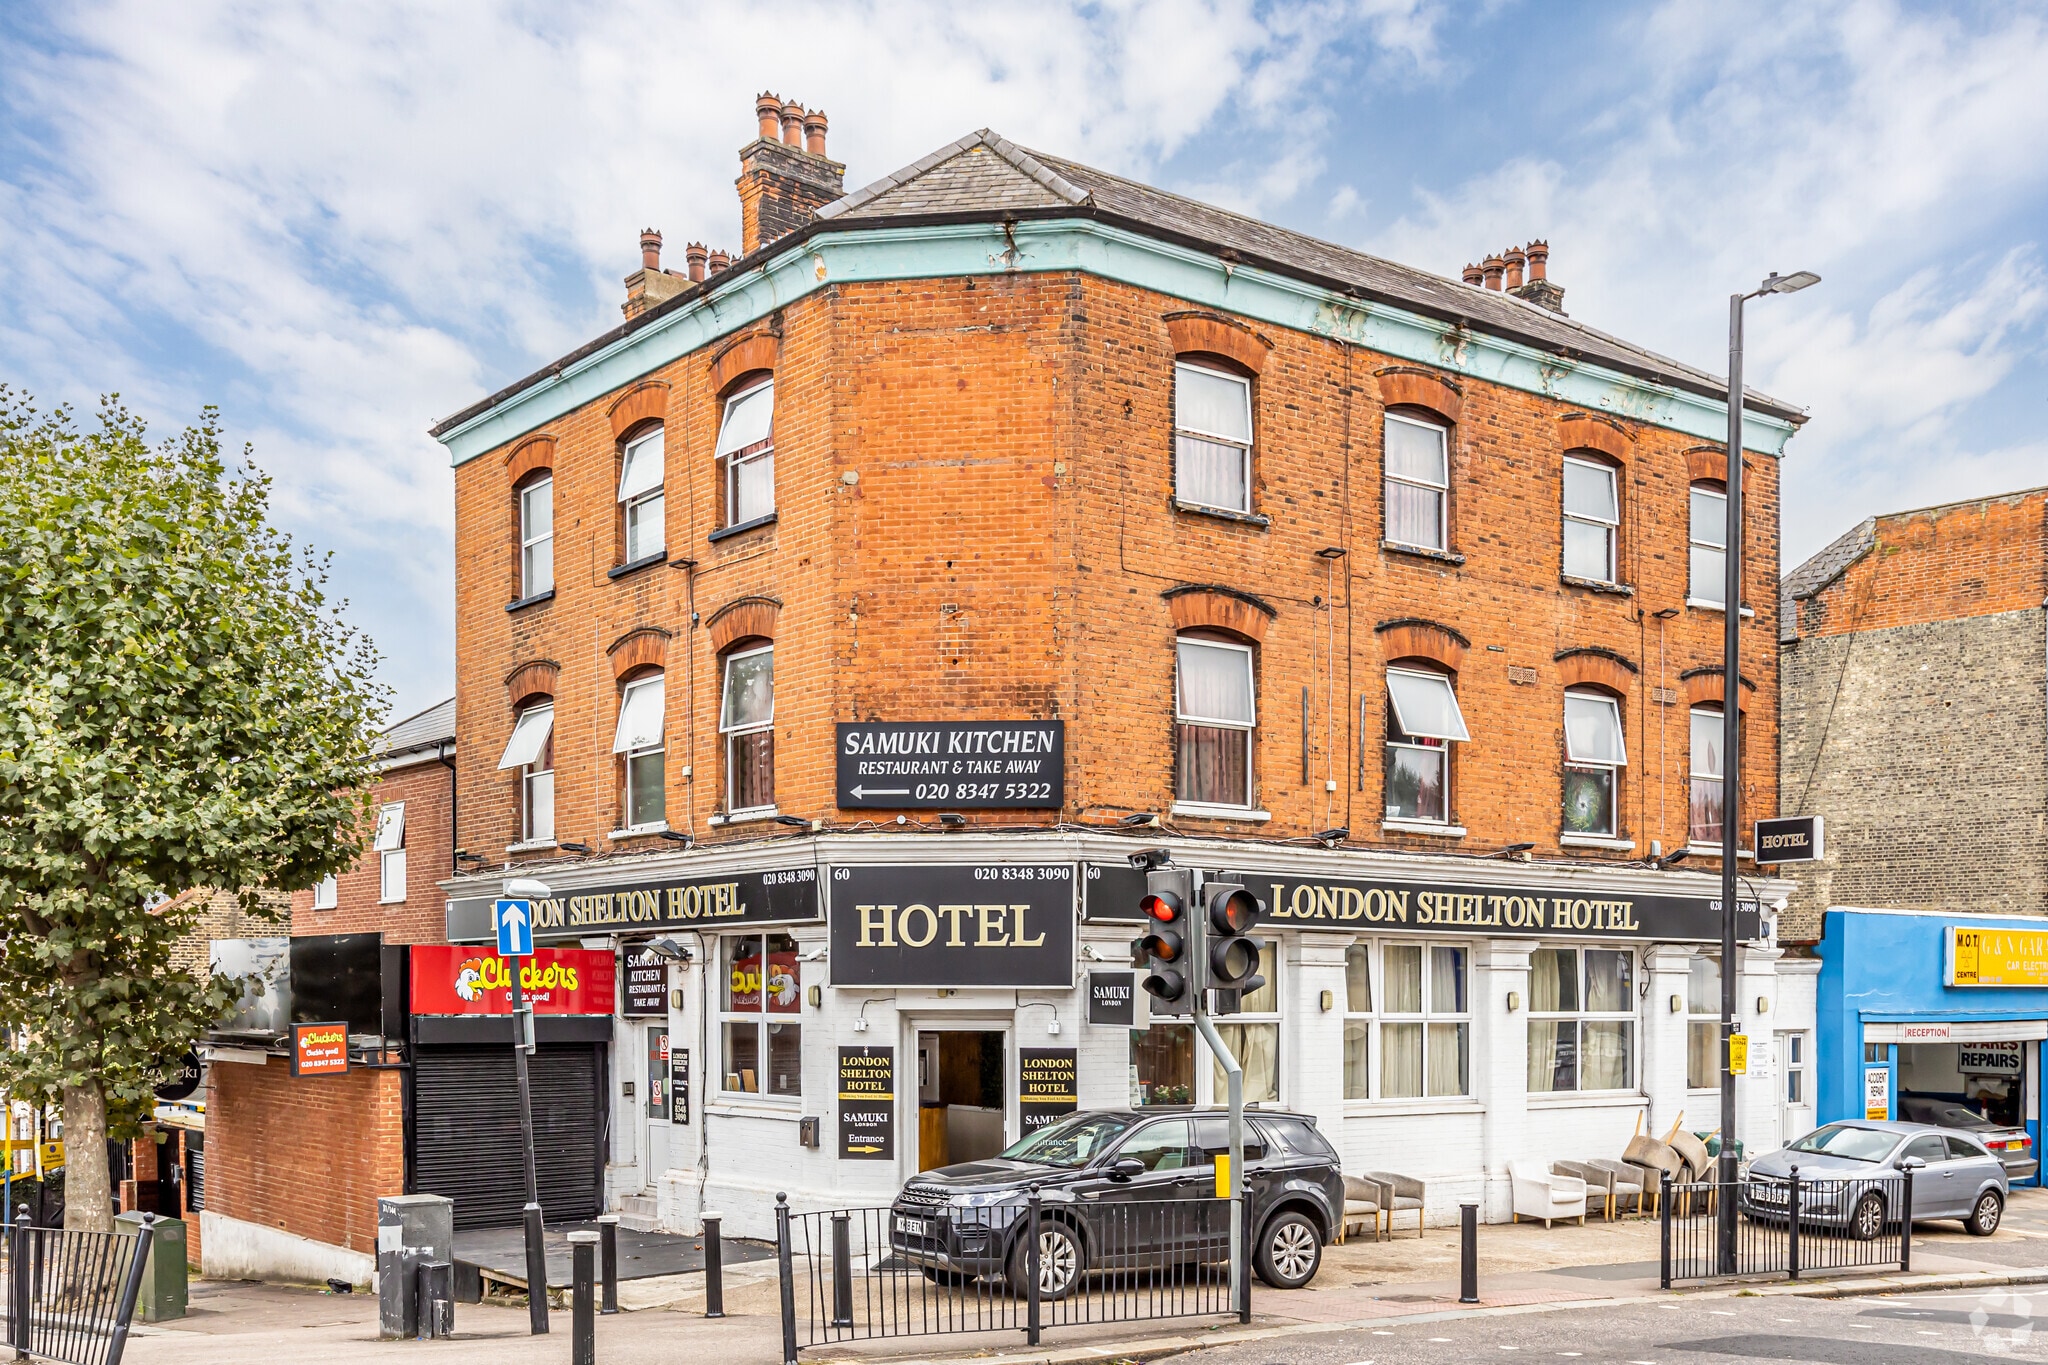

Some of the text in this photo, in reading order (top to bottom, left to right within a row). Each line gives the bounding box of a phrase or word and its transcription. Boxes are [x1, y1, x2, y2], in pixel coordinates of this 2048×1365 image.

[844, 730, 1055, 755] SAMUKI KITCHEN
[858, 759, 1041, 775] RESTAURANT & TAKE AWAY
[915, 783, 1051, 799] 020 8347 5322
[1762, 833, 1809, 849] HOTEL
[763, 869, 815, 886] 020 8348 3090
[834, 868, 850, 881] 60
[974, 868, 1070, 881] 020 8348 3090
[1087, 867, 1101, 880] 60
[490, 882, 746, 931] DON SHELTON HOTEL
[1270, 883, 1639, 931] LONDON SHELTON HOTEL
[1709, 901, 1723, 911] 020
[1740, 903, 1757, 912] 3090
[855, 903, 1046, 948] HOTEL
[1982, 935, 1991, 955] G
[2019, 936, 2048, 957] GAR
[2006, 960, 2020, 971] CAR
[631, 969, 661, 982] KITCHEN
[1956, 971, 1977, 979] CENTRE
[628, 983, 666, 994] RESTAURANT &
[1093, 986, 1130, 999] SAMUKI
[633, 997, 660, 1007] TAKE AWAY
[307, 1032, 344, 1045] Cluckers
[842, 1056, 890, 1067] LONDON
[1024, 1058, 1073, 1069] LONDON
[1961, 1053, 2019, 1069] REPAIRS
[840, 1068, 892, 1079] SHELTON
[1022, 1071, 1075, 1081] SHELTON
[1867, 1072, 1887, 1084] ACCIDENT
[847, 1081, 886, 1091] HOTEL
[1029, 1083, 1069, 1093] HOTEL
[1870, 1085, 1885, 1097] REPAIR
[843, 1112, 888, 1123] SAMUKI
[1025, 1115, 1061, 1125] SAM
[848, 1134, 885, 1143] Entrance
[1035, 1139, 1068, 1147] ntrance
